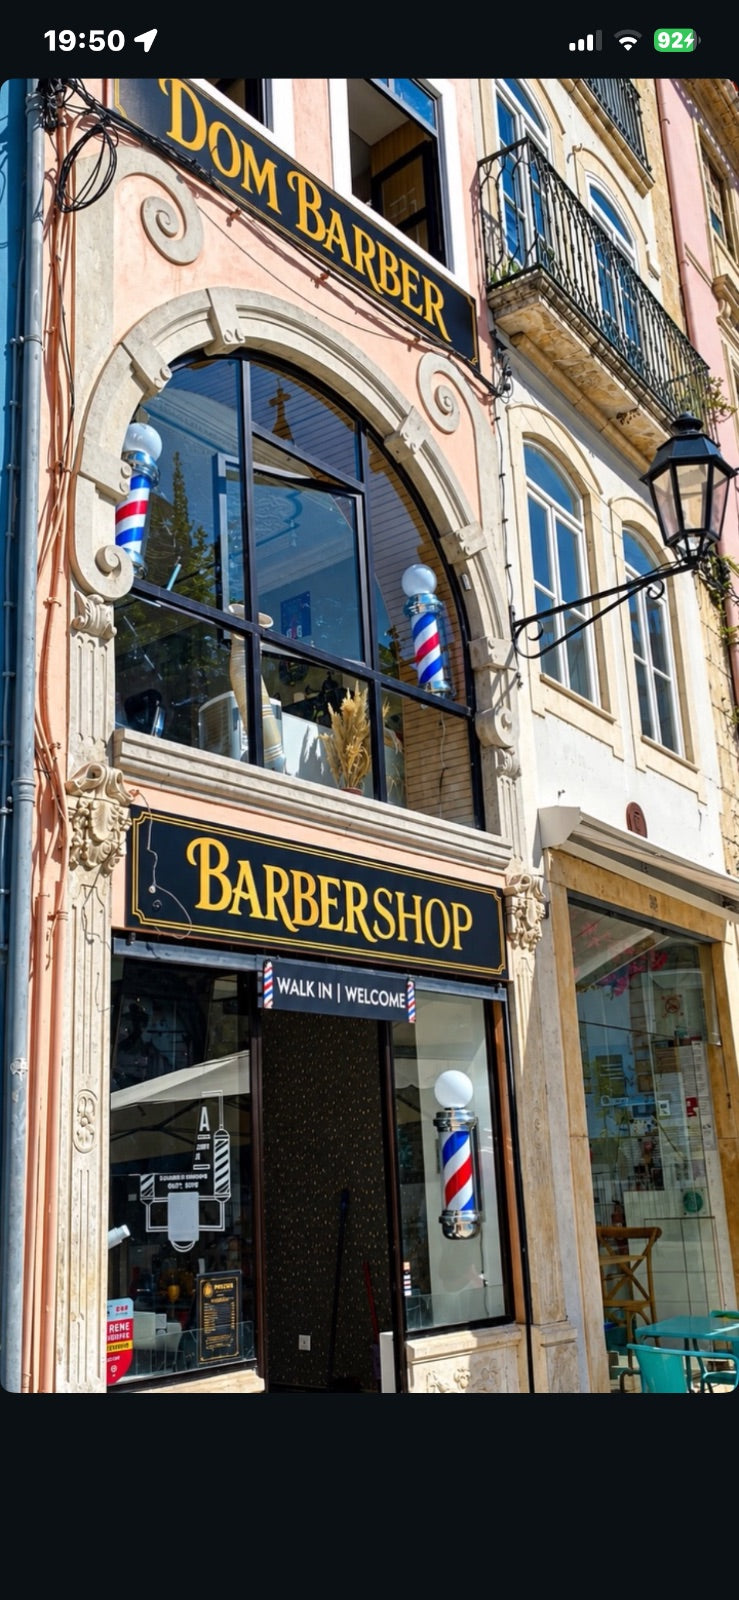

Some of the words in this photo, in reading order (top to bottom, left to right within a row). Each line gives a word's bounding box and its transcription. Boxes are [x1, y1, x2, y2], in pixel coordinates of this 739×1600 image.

[158, 78, 282, 215] DOM
[287, 170, 452, 342] BARBER
[186, 836, 473, 951] BARBERSHOP
[276, 976, 315, 998] WALK
[318, 981, 332, 1000] IN
[345, 985, 406, 1009] WELCOME
